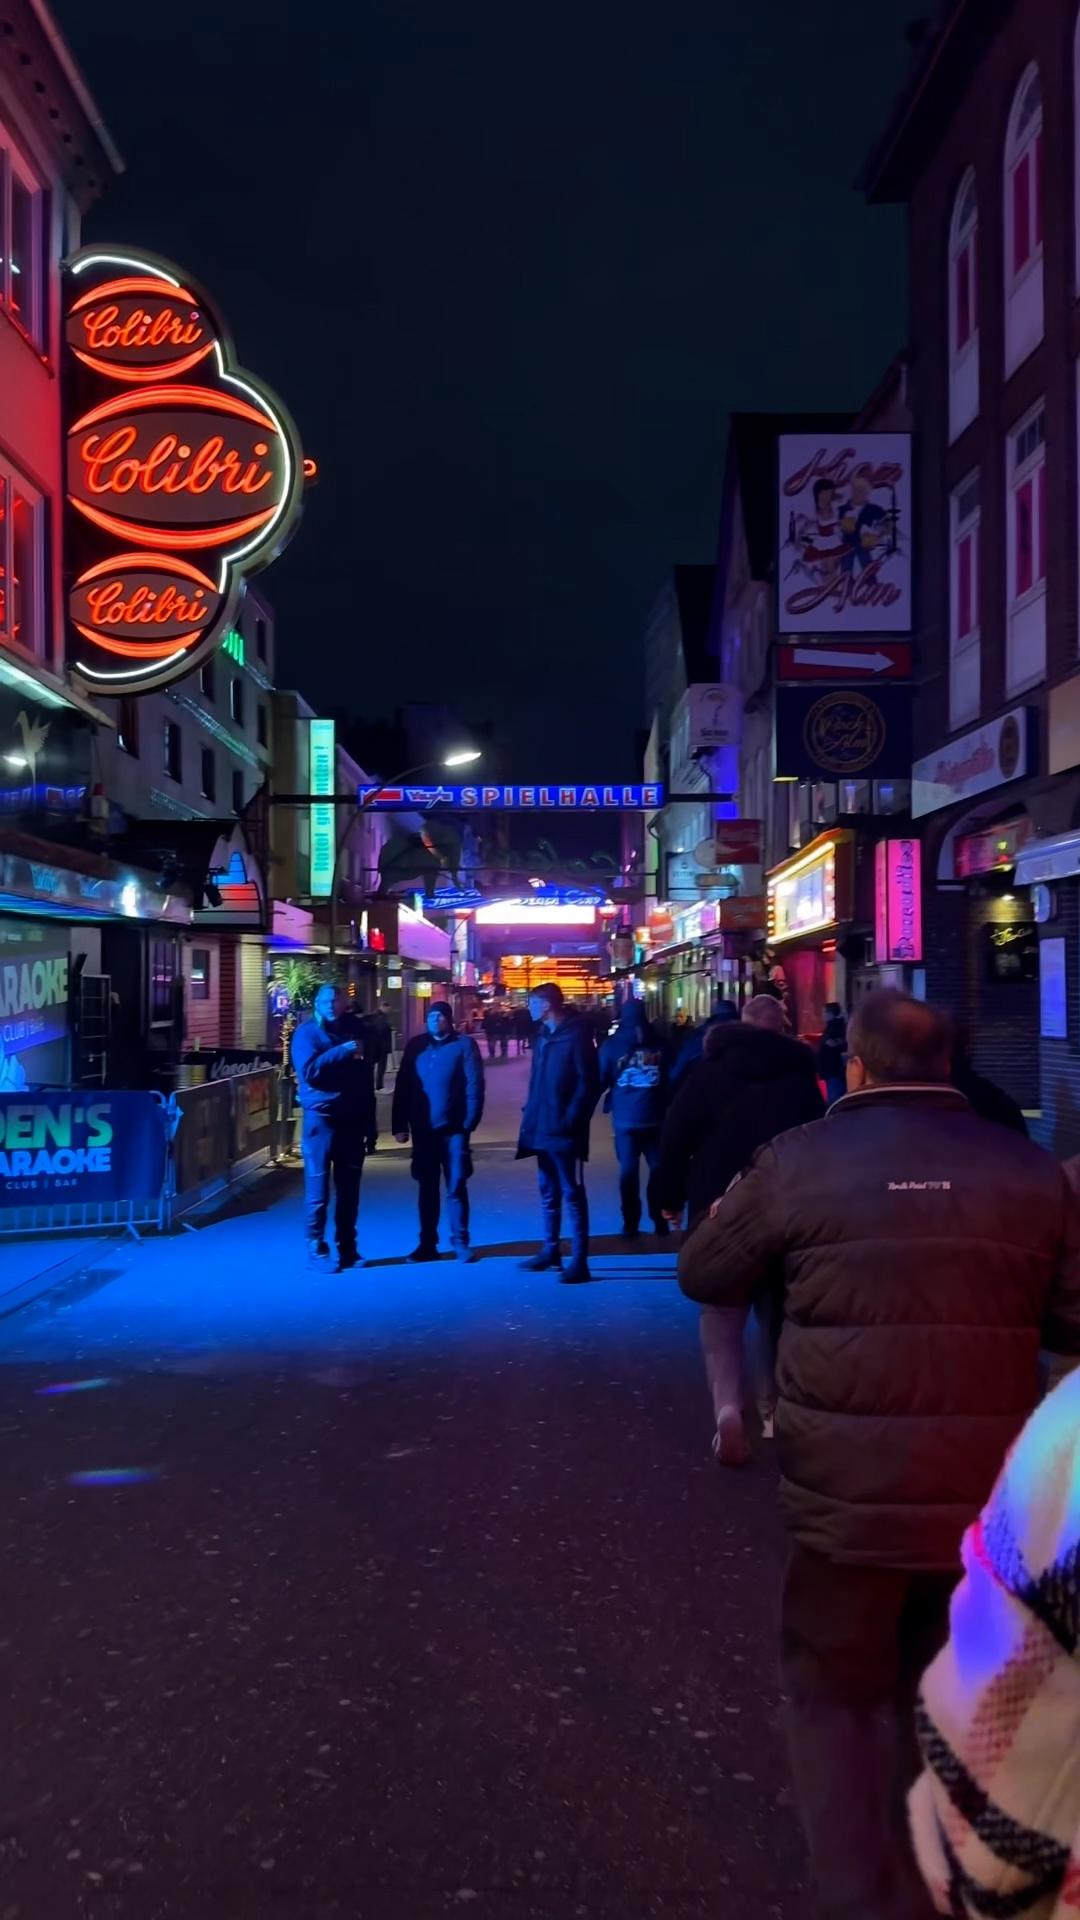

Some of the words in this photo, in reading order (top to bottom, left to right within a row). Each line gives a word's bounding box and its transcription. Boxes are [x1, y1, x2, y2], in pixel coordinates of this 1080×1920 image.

[83, 306, 202, 349] Colibri
[81, 425, 271, 495] Colibri
[87, 581, 207, 625] Colibri
[460, 786, 659, 807] SPIELHALLE
